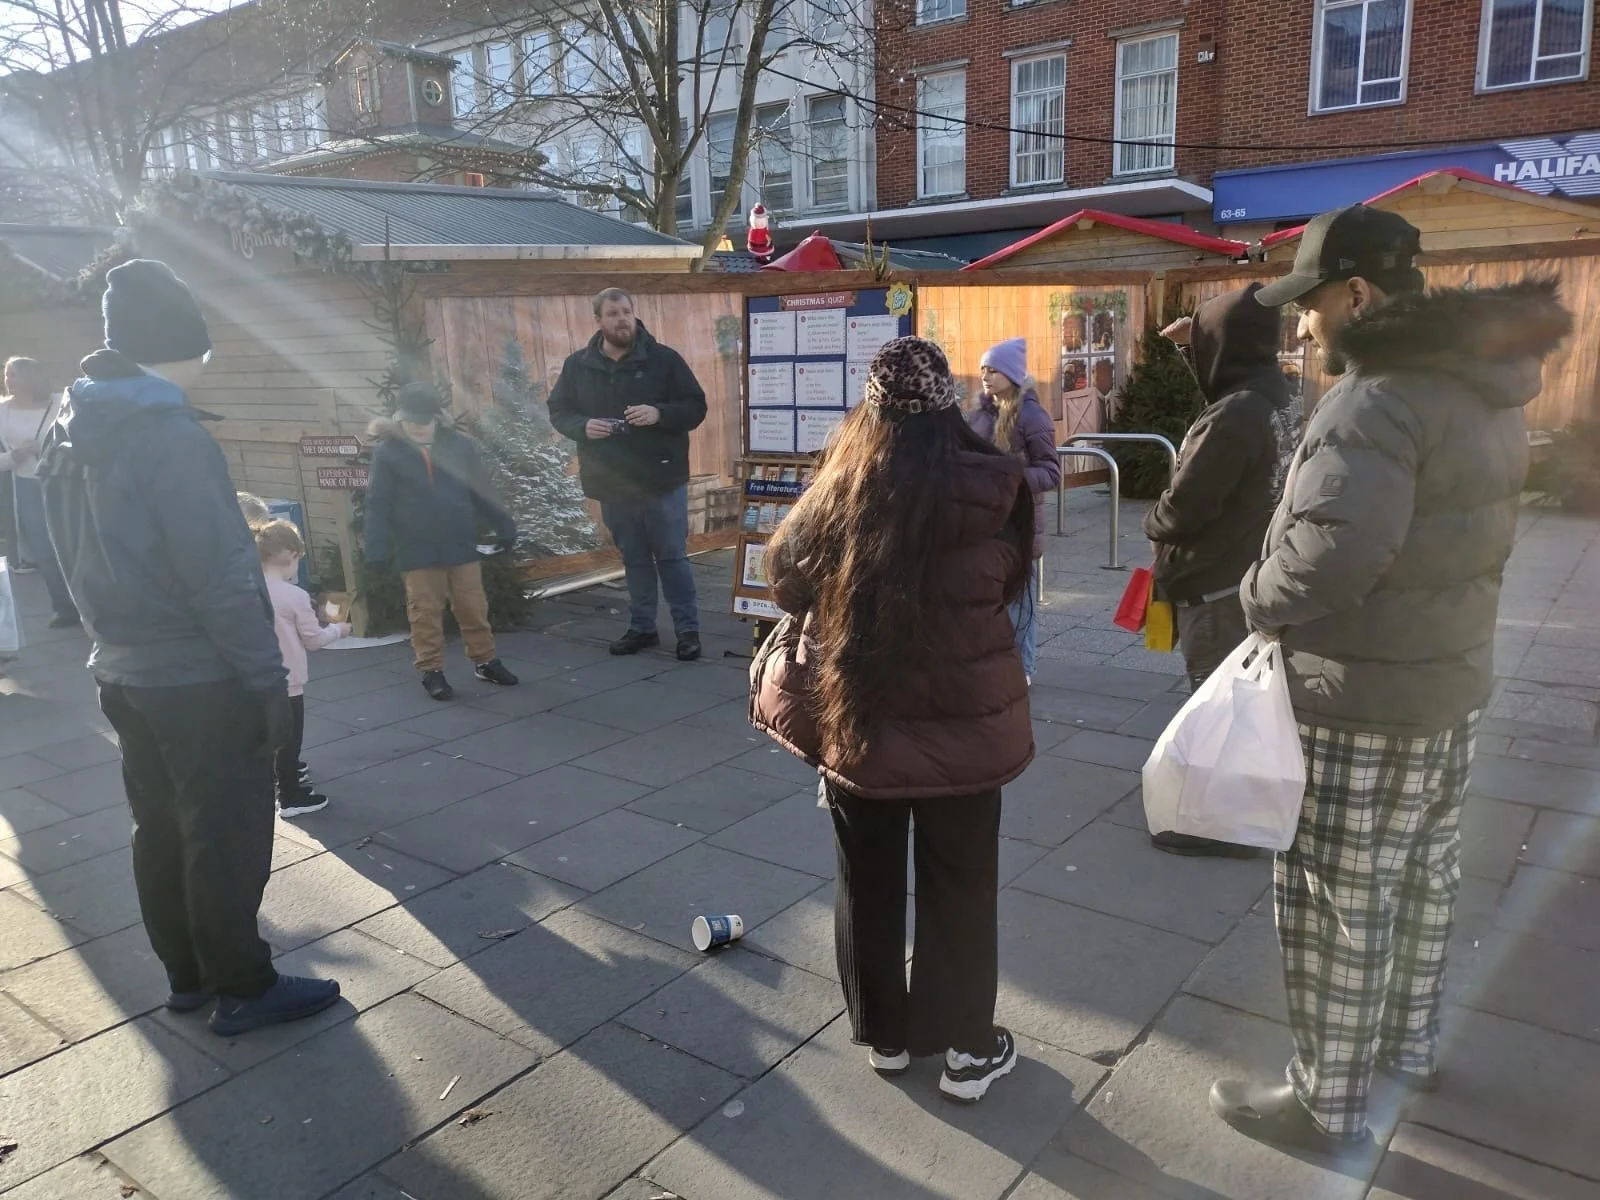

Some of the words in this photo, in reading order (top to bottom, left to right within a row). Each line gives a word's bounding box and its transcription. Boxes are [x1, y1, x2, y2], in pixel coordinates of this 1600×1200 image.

[1494, 154, 1600, 182] HALIFA
[1220, 208, 1246, 219] 63-65
[786, 298, 825, 306] CHRISTMAS
[827, 295, 845, 304] QUIZ!
[750, 483, 765, 491] Free
